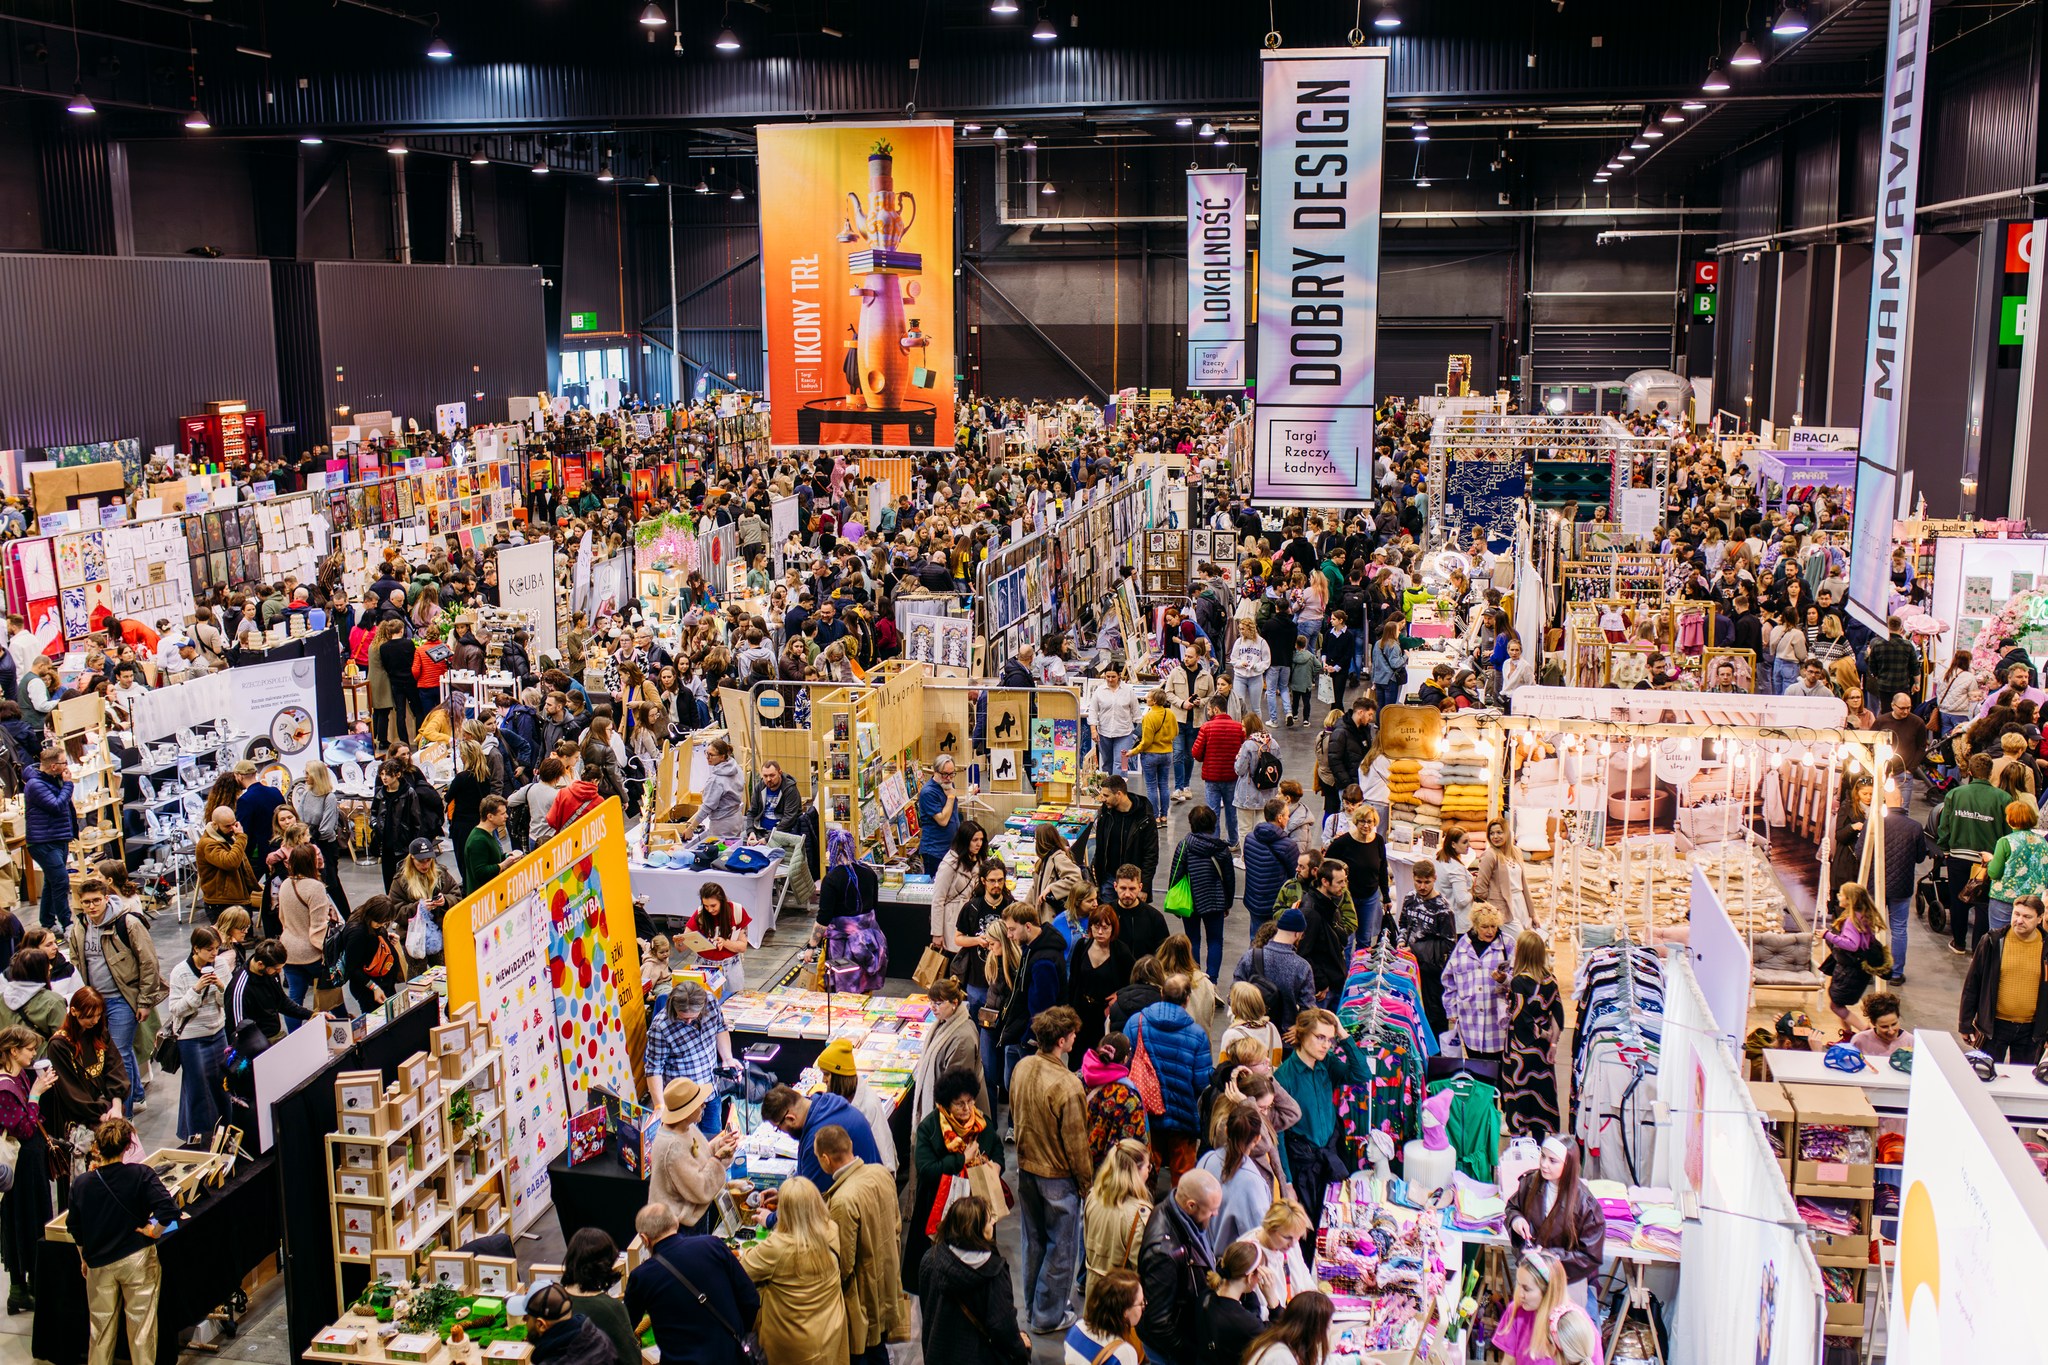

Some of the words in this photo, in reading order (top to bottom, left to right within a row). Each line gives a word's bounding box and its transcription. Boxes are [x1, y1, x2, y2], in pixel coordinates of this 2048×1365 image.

[1293, 80, 1350, 229] DESIGN
[1196, 197, 1231, 323] LOKALNOŚĆ
[790, 253, 820, 293] TRŁ
[1700, 264, 1714, 281] C
[1699, 296, 1711, 312] B
[1289, 247, 1345, 386] DOBRY
[792, 299, 822, 363] IKONY
[1202, 351, 1219, 363] Targi
[1202, 360, 1225, 372] Rzeczy
[1285, 429, 1317, 444] Targi
[1793, 432, 1839, 443] BRACIA
[1285, 446, 1330, 460] Rzeczy
[1284, 461, 1337, 476] Ładnych
[1922, 523, 1935, 533] più
[471, 890, 497, 932] BUKA
[506, 857, 544, 906] FORMAT
[551, 837, 573, 874] TAKO
[581, 813, 607, 853] ALBUS
[556, 894, 601, 938] BABARYBA
